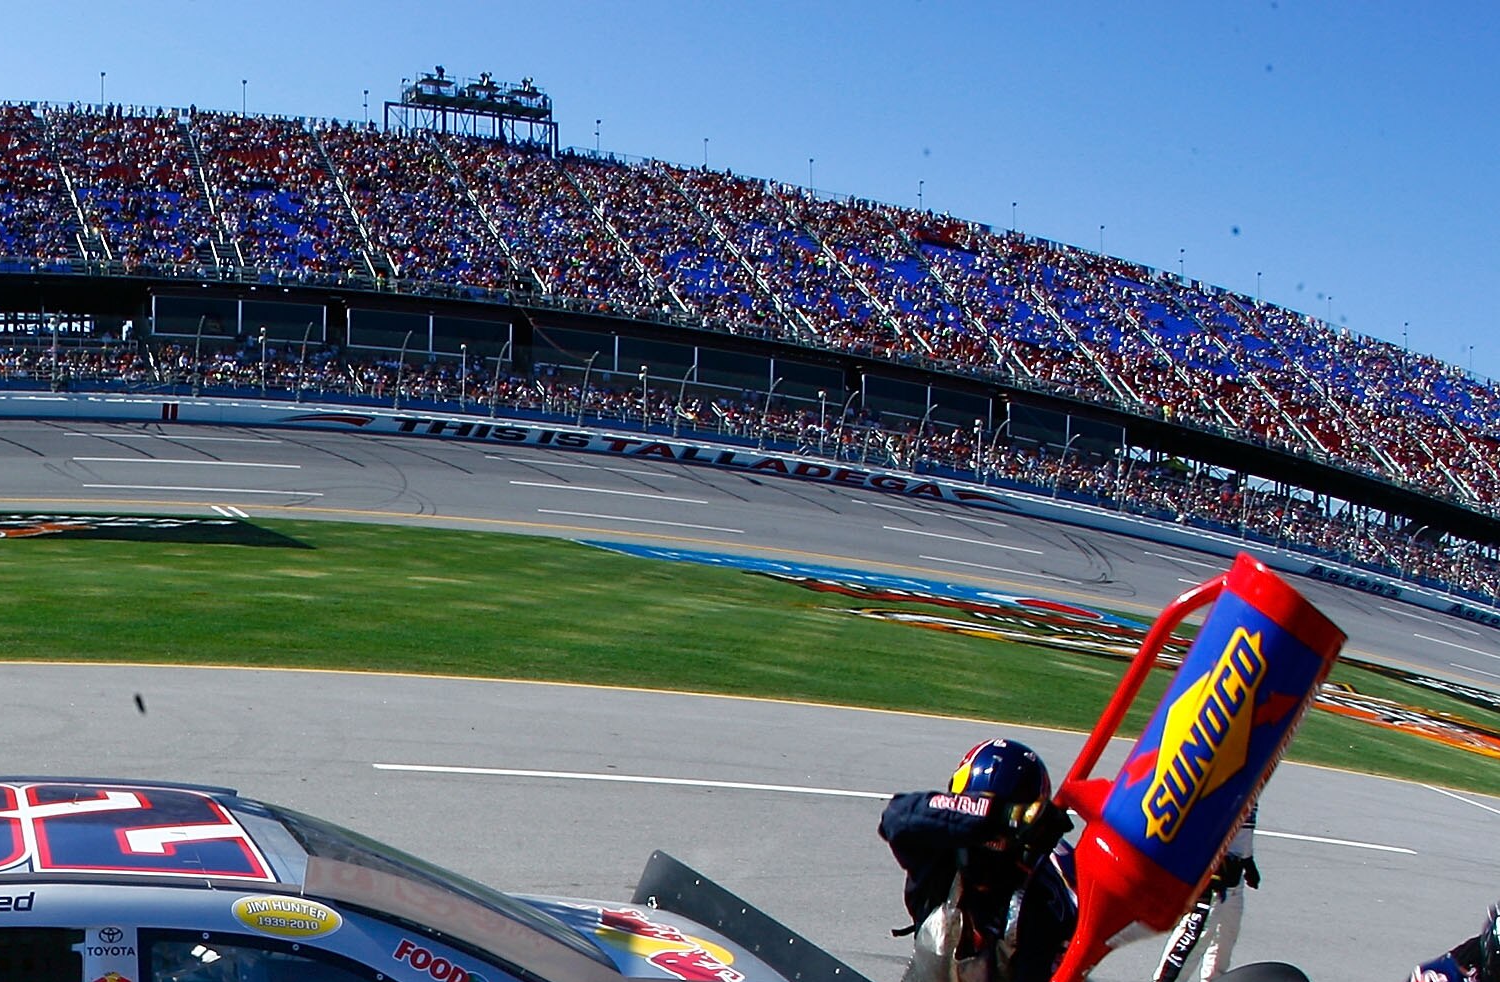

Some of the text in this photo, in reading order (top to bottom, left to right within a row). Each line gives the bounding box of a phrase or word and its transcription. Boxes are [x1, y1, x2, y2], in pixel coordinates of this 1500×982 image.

[395, 417, 944, 500] THIS IS TALLADEGA
[1148, 637, 1262, 836] SUNOCO
[246, 901, 328, 921] JIM HUNTER
[257, 916, 319, 930] 1939-2010
[87, 946, 135, 956] TOYOTA
